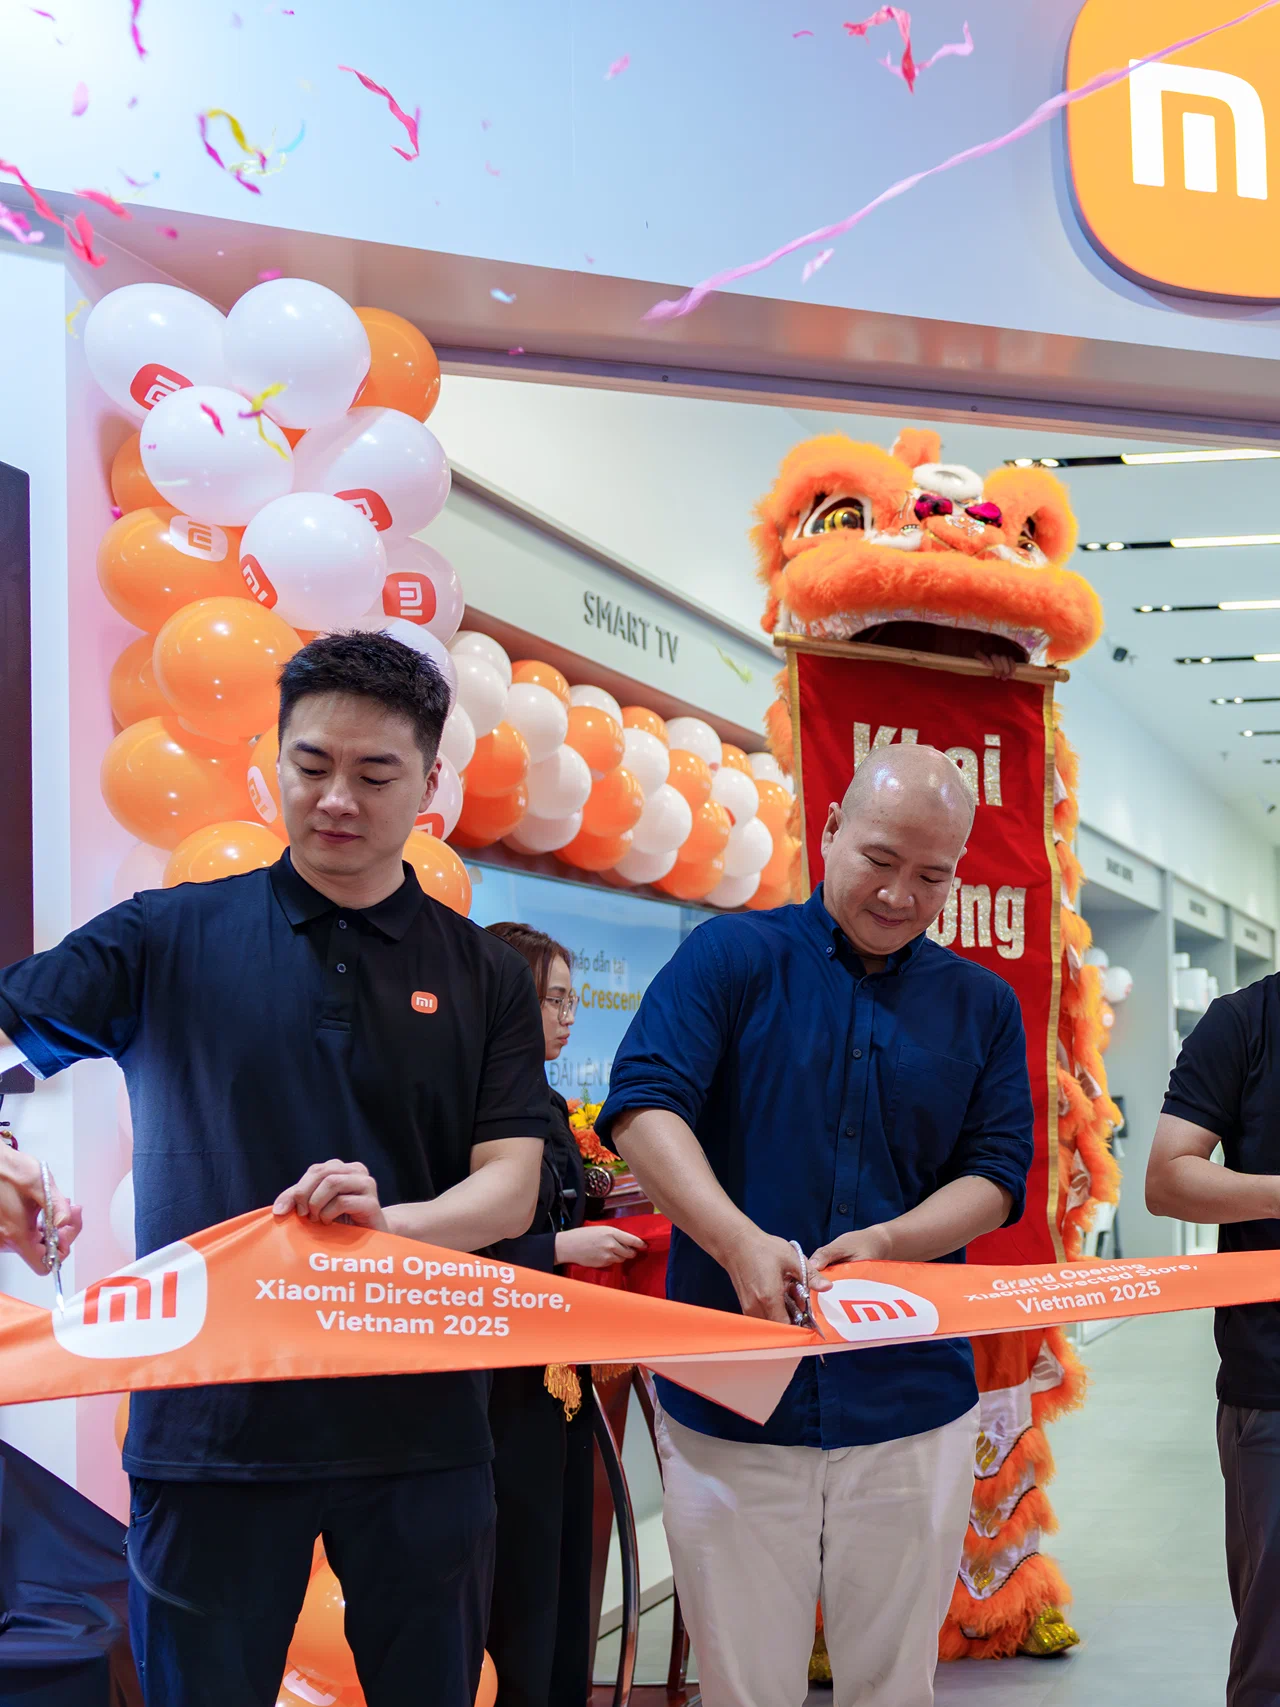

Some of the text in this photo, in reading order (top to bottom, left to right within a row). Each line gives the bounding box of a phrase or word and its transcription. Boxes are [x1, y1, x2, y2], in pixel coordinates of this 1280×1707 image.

[584, 590, 678, 664] SMART TV
[581, 982, 643, 1012] Crescent
[308, 1252, 515, 1284] Grand Opening
[963, 1263, 1199, 1302] Xiaomi Directed Store,
[992, 1262, 1146, 1292] Grand Opening
[255, 1279, 572, 1313] Xiaomi Directed Store,
[1016, 1280, 1161, 1314] Vietnam 2025
[315, 1310, 510, 1337] Vietnam 2025
